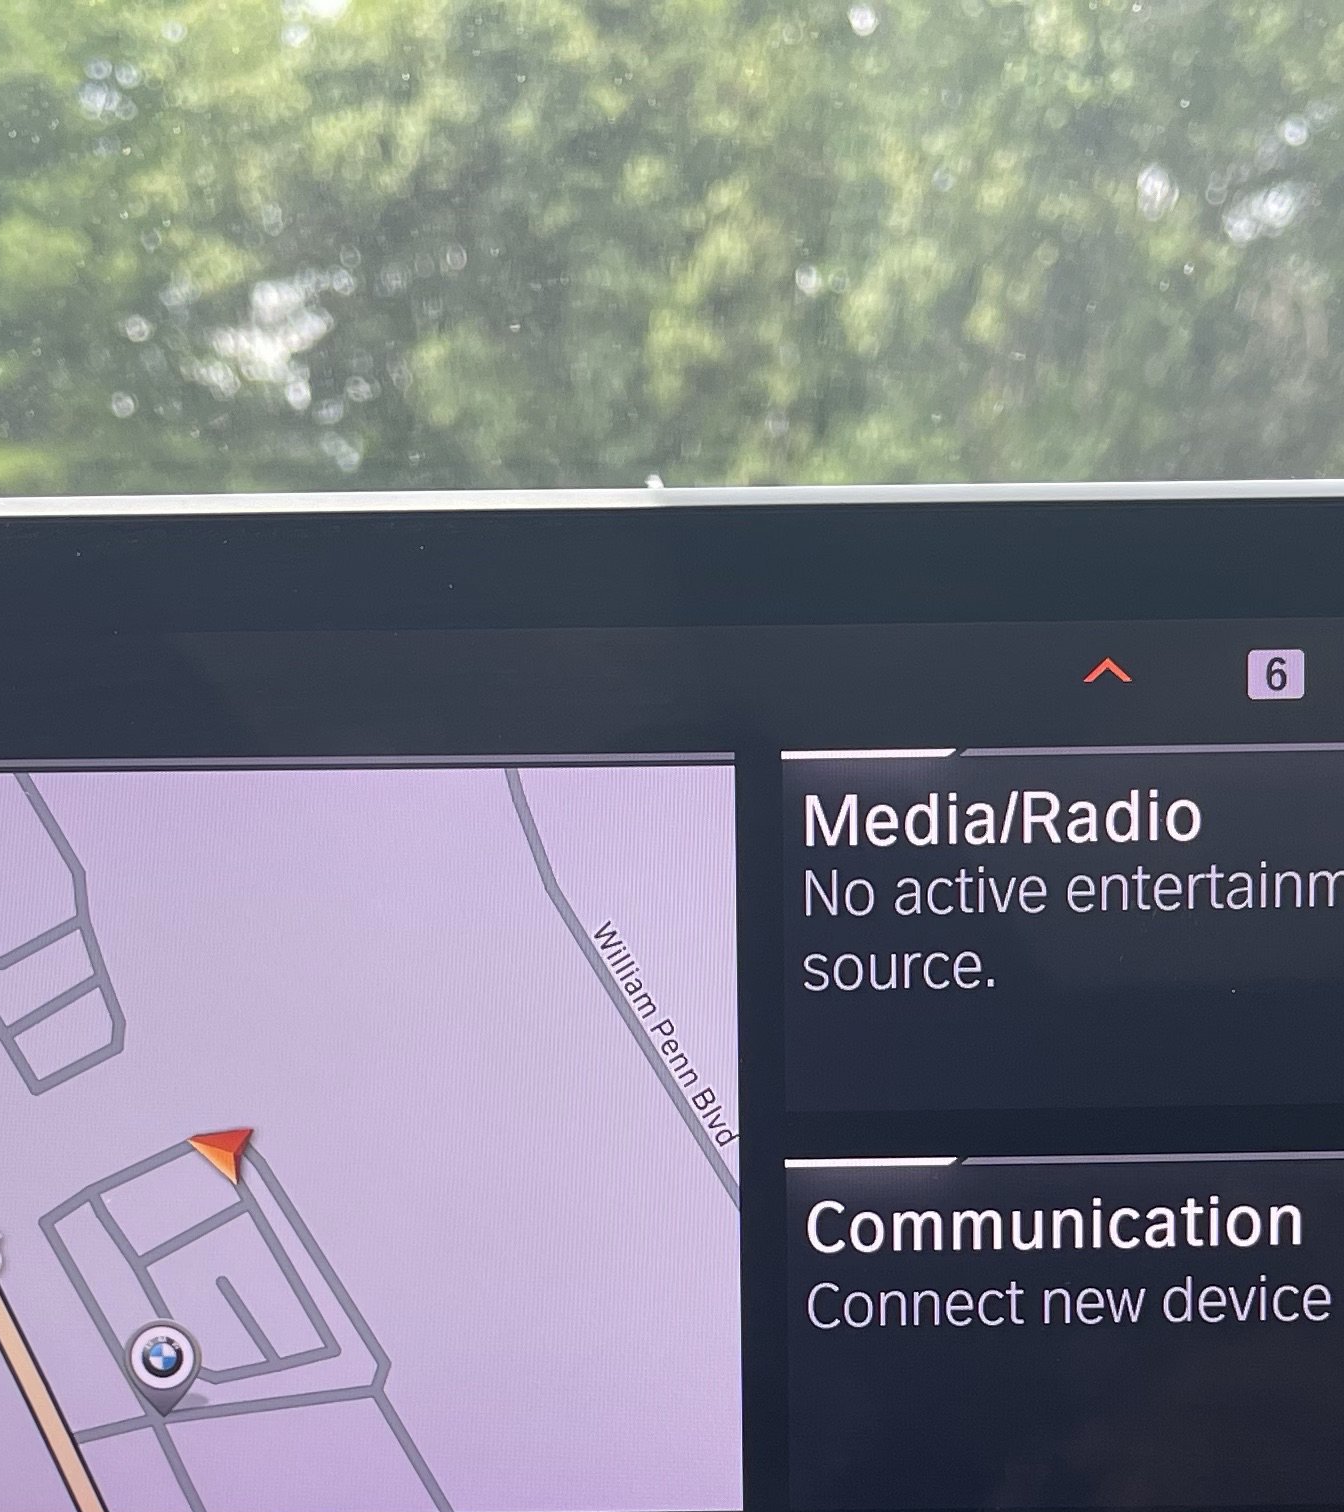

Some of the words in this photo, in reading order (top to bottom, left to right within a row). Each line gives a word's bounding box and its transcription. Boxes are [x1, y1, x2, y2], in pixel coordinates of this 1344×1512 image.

[1265, 656, 1288, 692] 6
[805, 789, 1202, 847] Media/Radio
[805, 869, 875, 917] No
[894, 865, 1047, 916] active
[803, 951, 995, 992] source.
[592, 919, 658, 1021] William
[648, 1017, 700, 1090] Penn
[690, 1085, 742, 1149] Blvd
[807, 1195, 1301, 1254] Communication
[807, 1281, 1025, 1329] Connect
[1044, 1287, 1146, 1325] new
[1163, 1274, 1332, 1323] device
